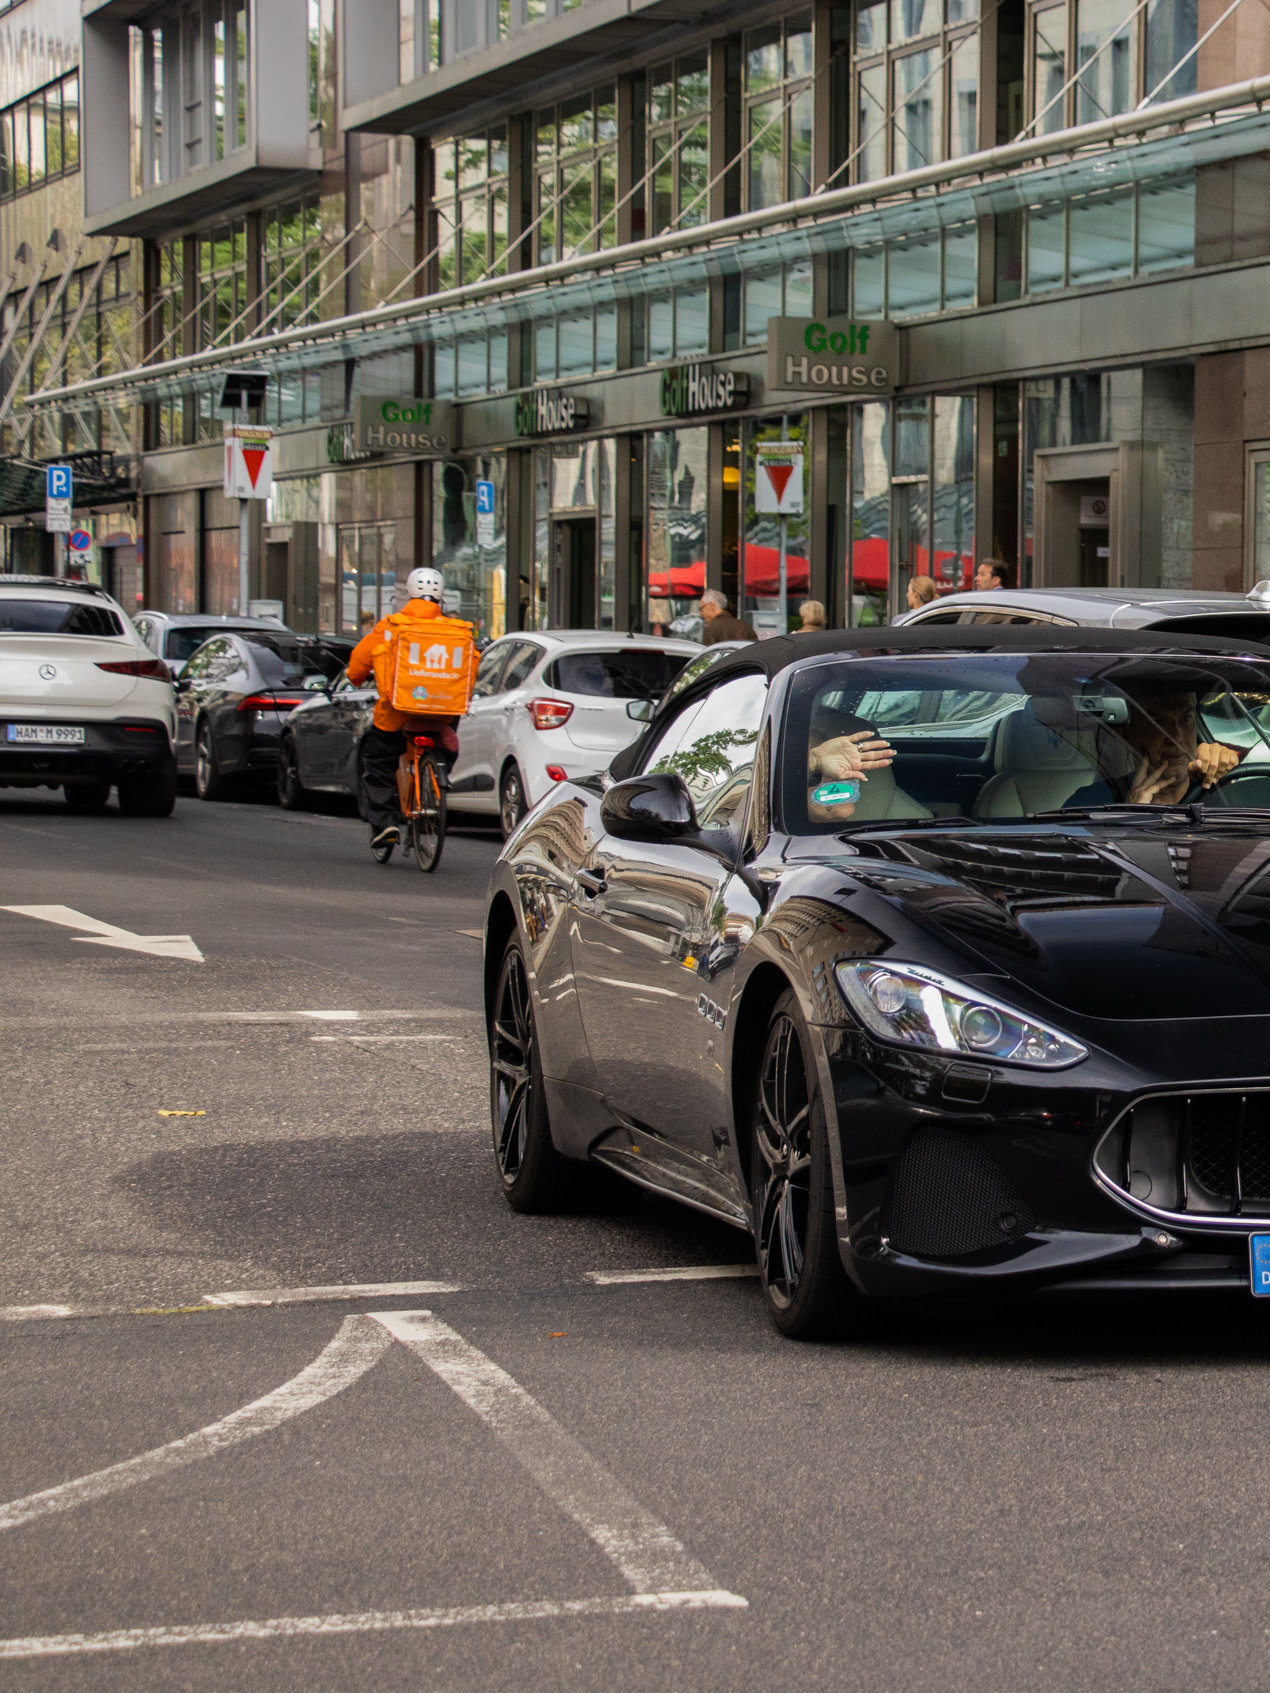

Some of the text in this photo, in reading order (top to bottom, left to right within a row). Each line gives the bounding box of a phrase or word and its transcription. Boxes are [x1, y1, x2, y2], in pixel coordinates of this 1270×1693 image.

[804, 322, 870, 354] Golf
[785, 355, 888, 387] House
[381, 400, 433, 425] Golf
[366, 425, 447, 450] House
[52, 470, 66, 495] P
